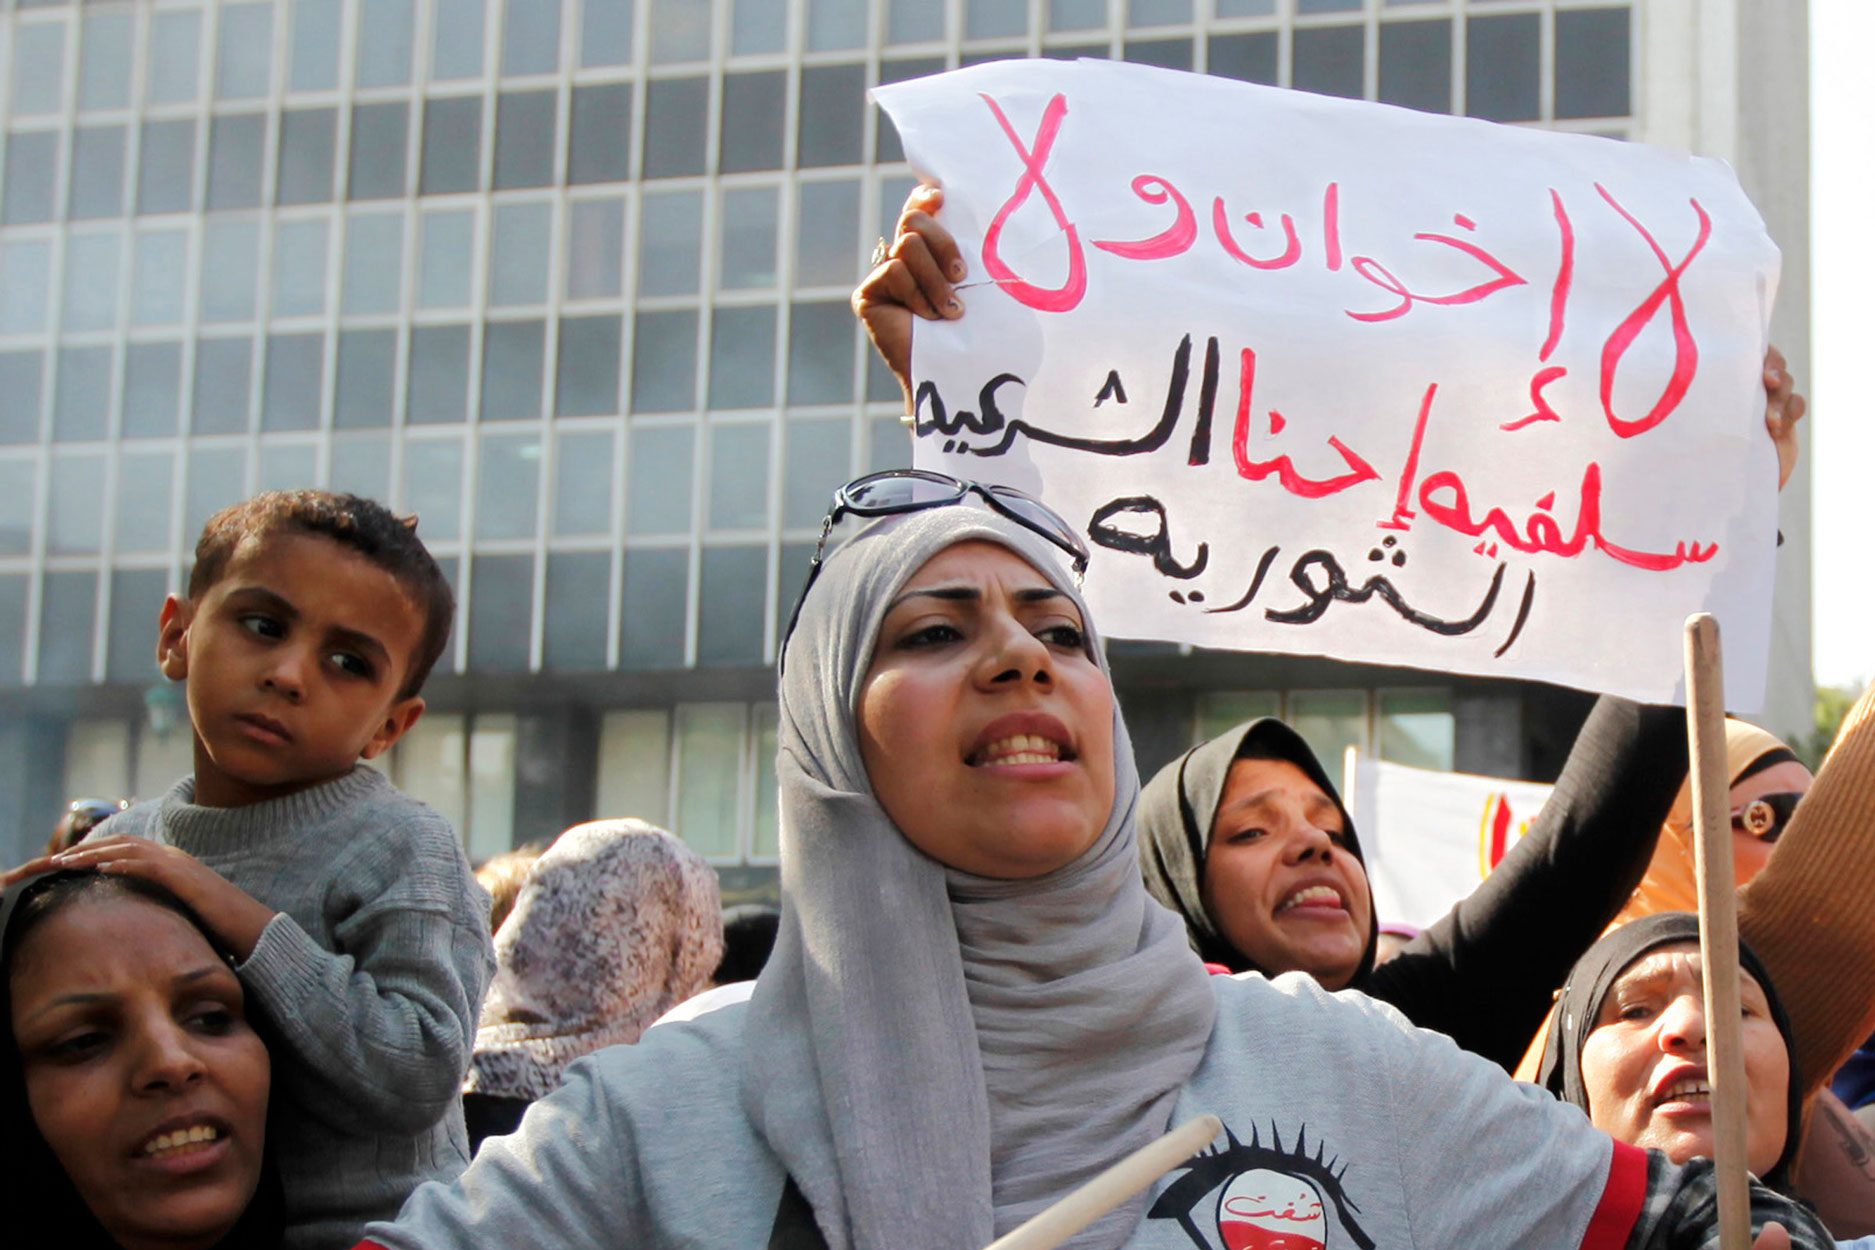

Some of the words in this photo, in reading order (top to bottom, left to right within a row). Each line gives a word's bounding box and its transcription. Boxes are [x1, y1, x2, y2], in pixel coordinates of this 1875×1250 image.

[1594, 179, 1712, 440] لا
[913, 333, 1221, 466] الشرعيه
[1087, 492, 1537, 659] الثوريه
